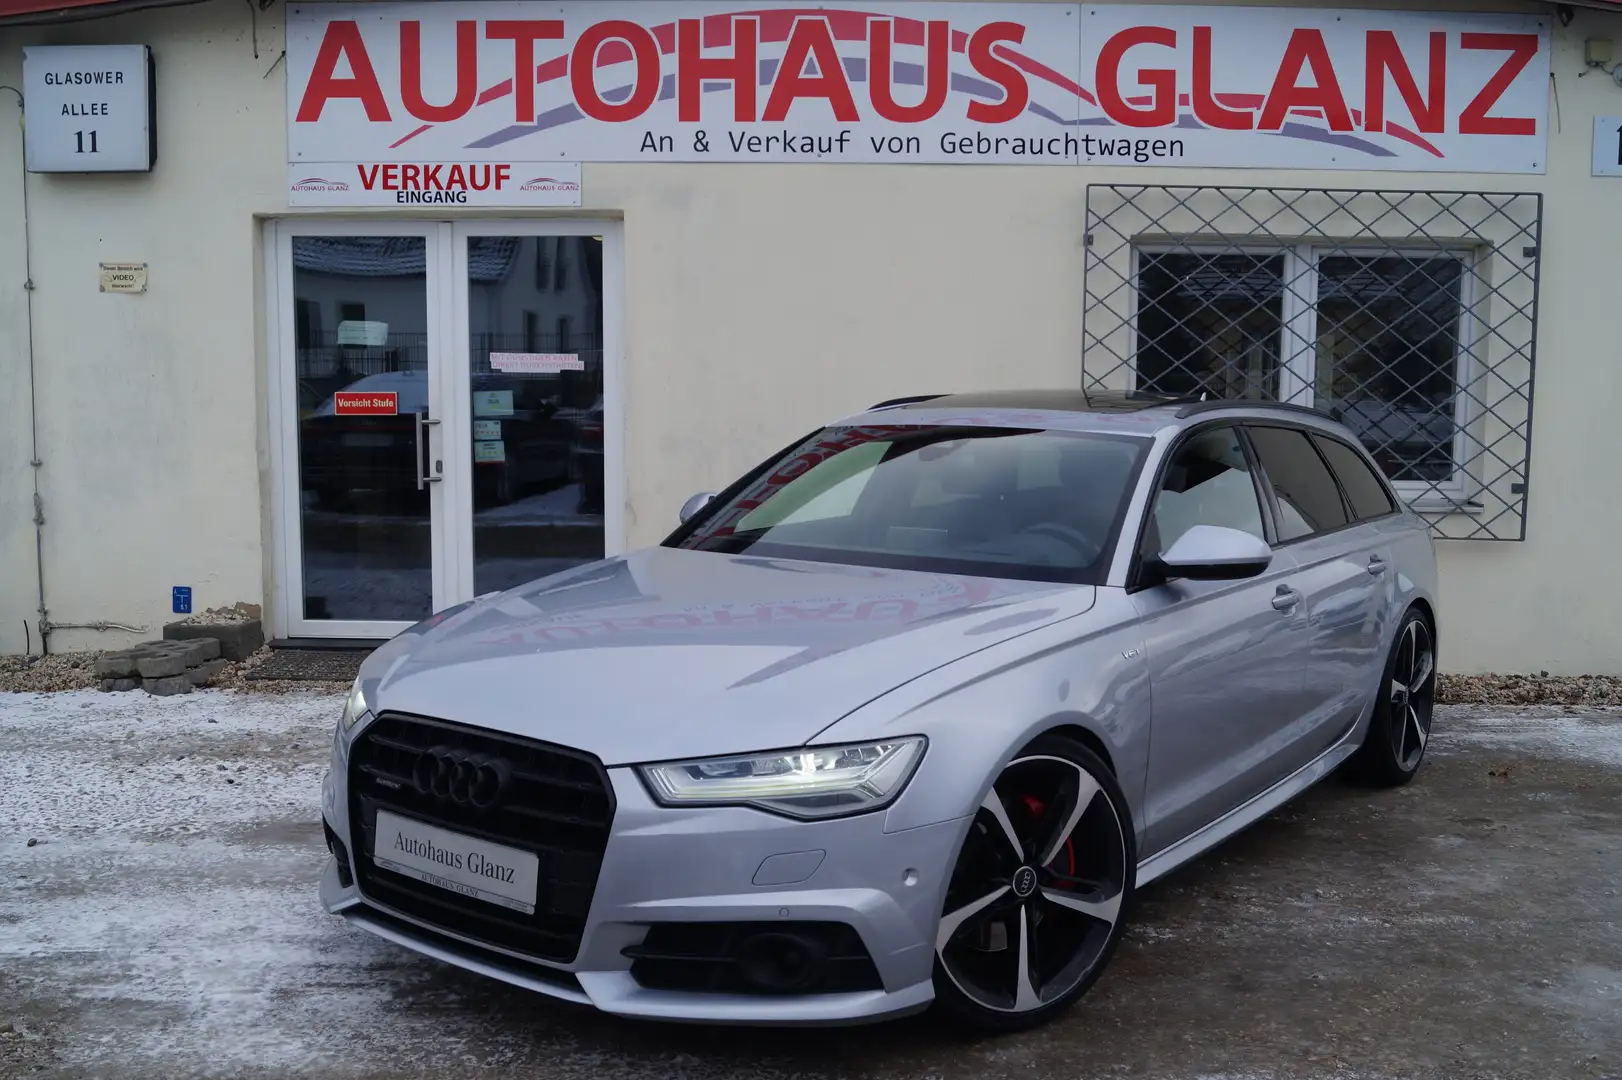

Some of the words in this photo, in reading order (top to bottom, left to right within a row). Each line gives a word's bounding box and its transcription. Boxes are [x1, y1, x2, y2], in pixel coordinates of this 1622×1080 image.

[44, 71, 124, 85] GLASOWER
[294, 19, 1030, 125] AUTOHAUS
[1094, 25, 1539, 136] GLANZ
[61, 103, 109, 116] ALLEE
[73, 130, 99, 153] 11
[640, 130, 674, 153] An
[693, 129, 710, 153] &
[728, 129, 851, 154] Verkauf
[870, 135, 921, 154] von
[940, 130, 1184, 163] Gebrauchtwagen
[357, 164, 511, 191] VERKAUF
[396, 190, 467, 204] EINGANG
[338, 398, 371, 407] Vorsicht
[373, 398, 394, 407] Stufe
[394, 831, 463, 870] Autohaus
[467, 852, 515, 884] Glanz
